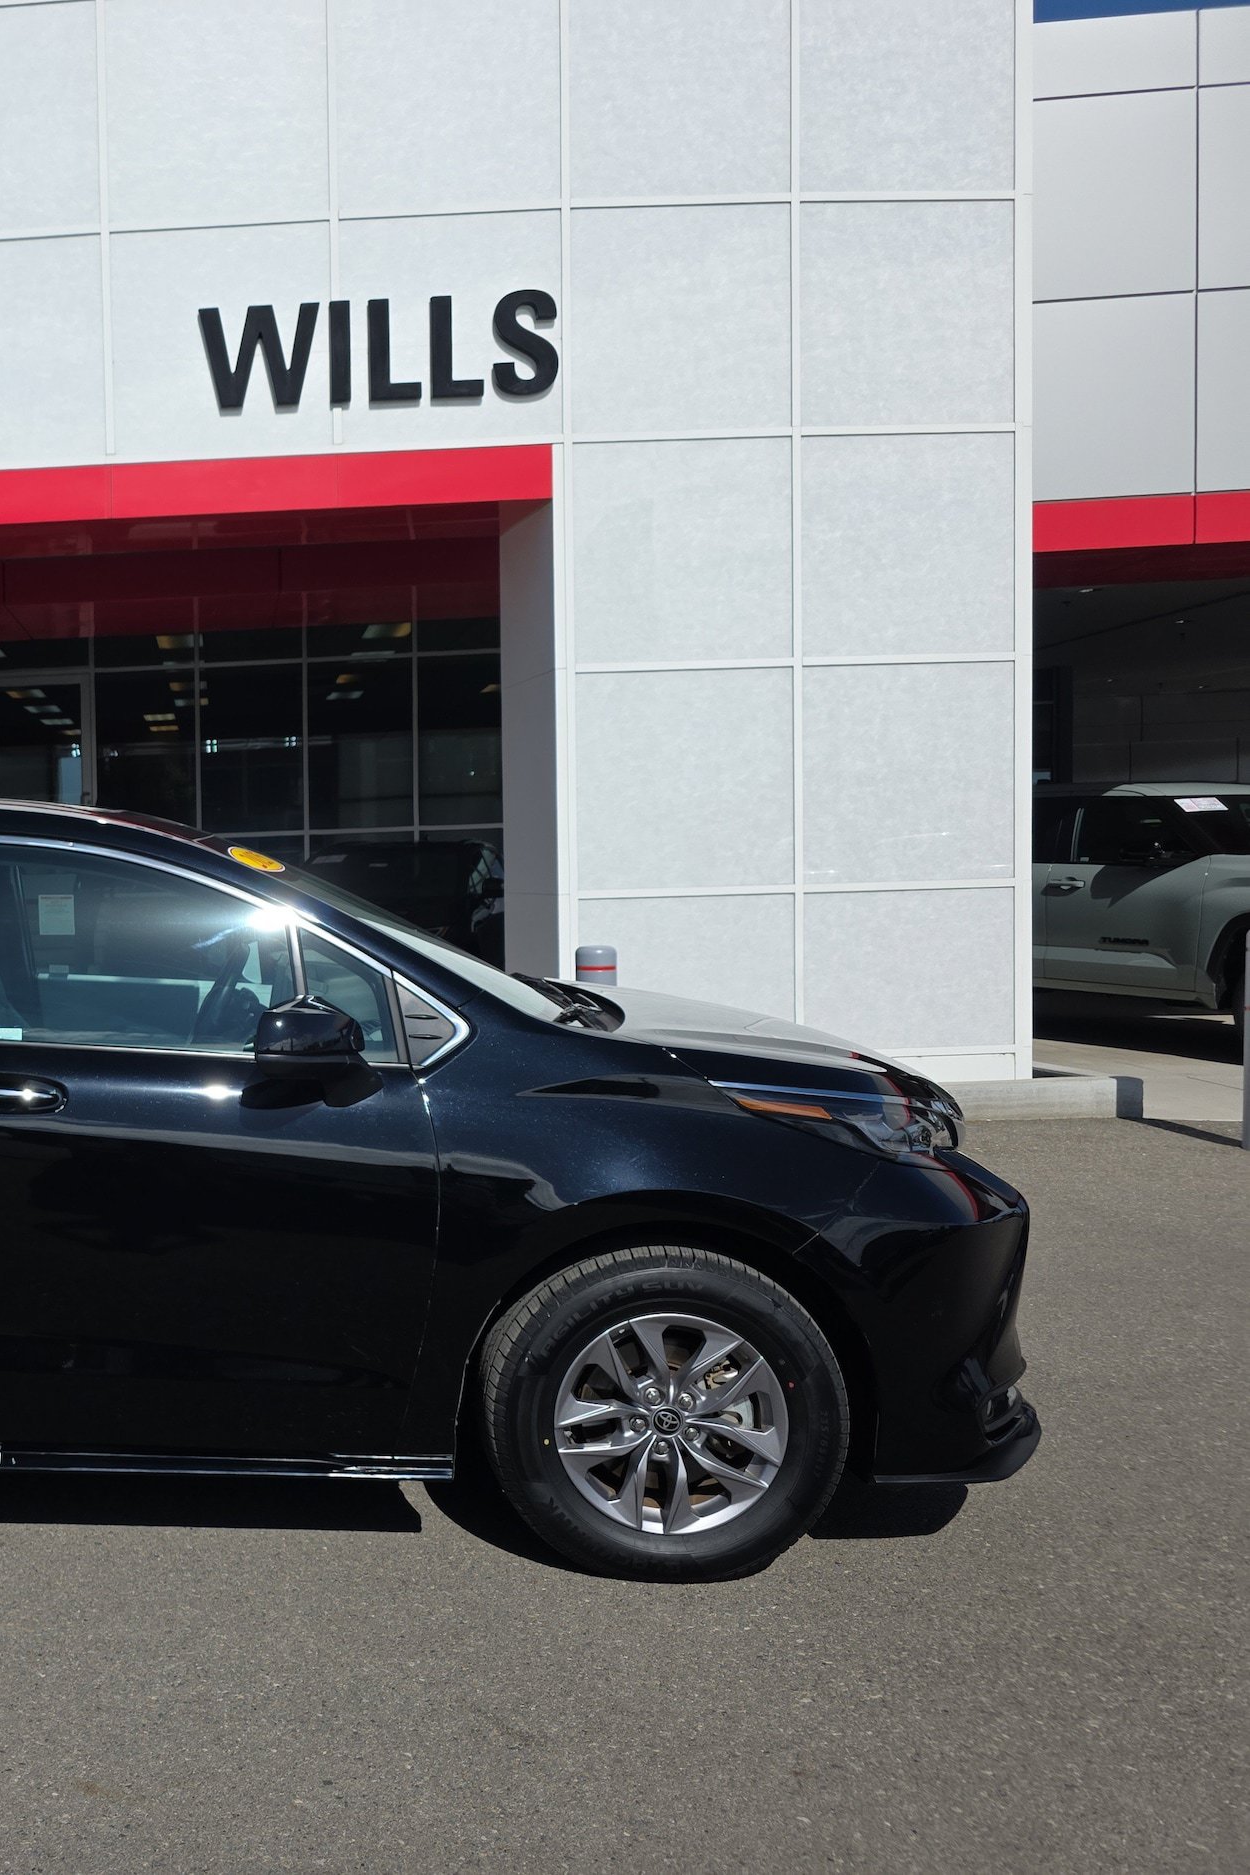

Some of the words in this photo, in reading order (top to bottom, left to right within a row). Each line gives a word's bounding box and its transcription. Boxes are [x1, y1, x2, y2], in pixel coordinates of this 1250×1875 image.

[198, 289, 559, 409] WILLS
[538, 1285, 634, 1358] AGILITY
[640, 1280, 704, 1293] SUV
